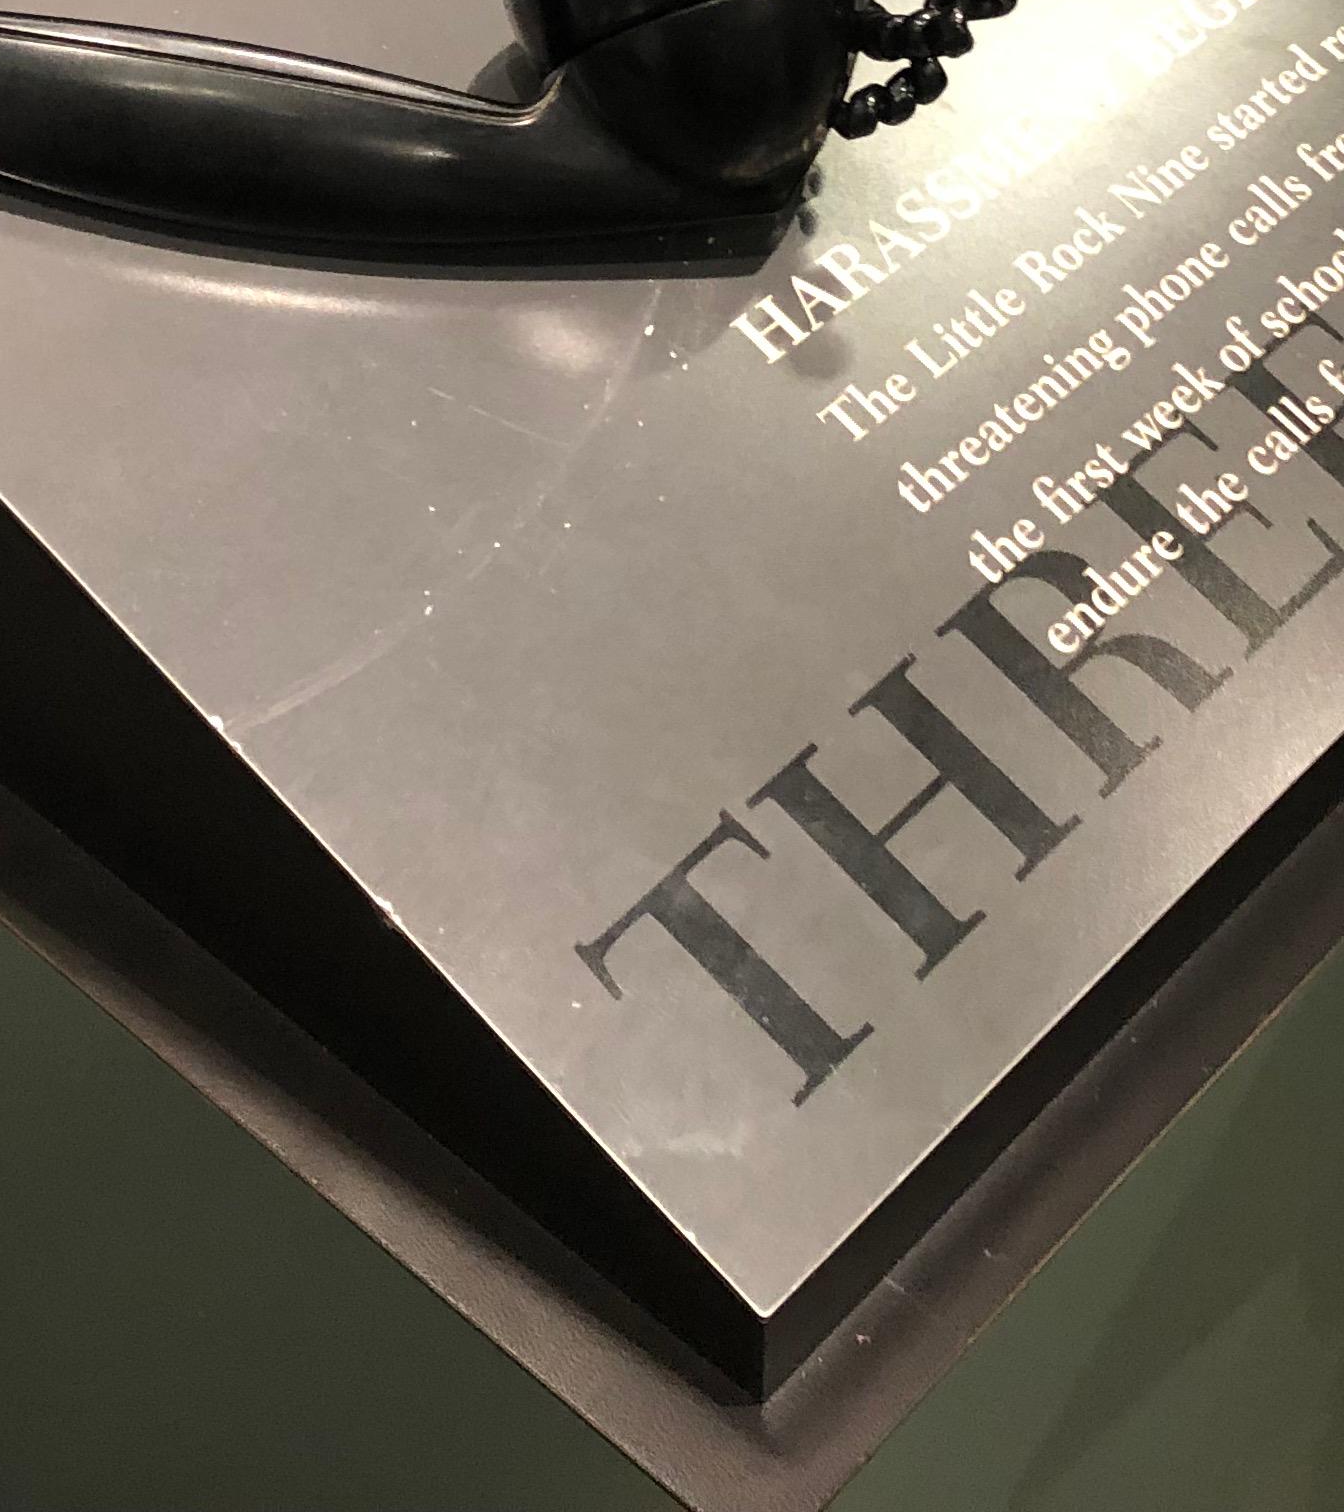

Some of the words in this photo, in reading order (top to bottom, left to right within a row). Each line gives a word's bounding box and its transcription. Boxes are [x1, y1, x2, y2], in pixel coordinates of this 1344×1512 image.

[815, 373, 916, 441] The
[904, 287, 1025, 378] Little
[1011, 205, 1125, 293] Rock
[1106, 144, 1208, 219] Nine
[1187, 43, 1327, 150] started
[897, 328, 1131, 512] threatening
[1114, 242, 1229, 347] phone
[1228, 174, 1312, 245] calls
[968, 518, 1044, 582] the
[1031, 443, 1128, 524] first
[1121, 362, 1224, 450] week
[1219, 315, 1263, 371] of
[1047, 531, 1181, 653] endure
[1175, 472, 1248, 534] the
[1247, 396, 1334, 475] calls
